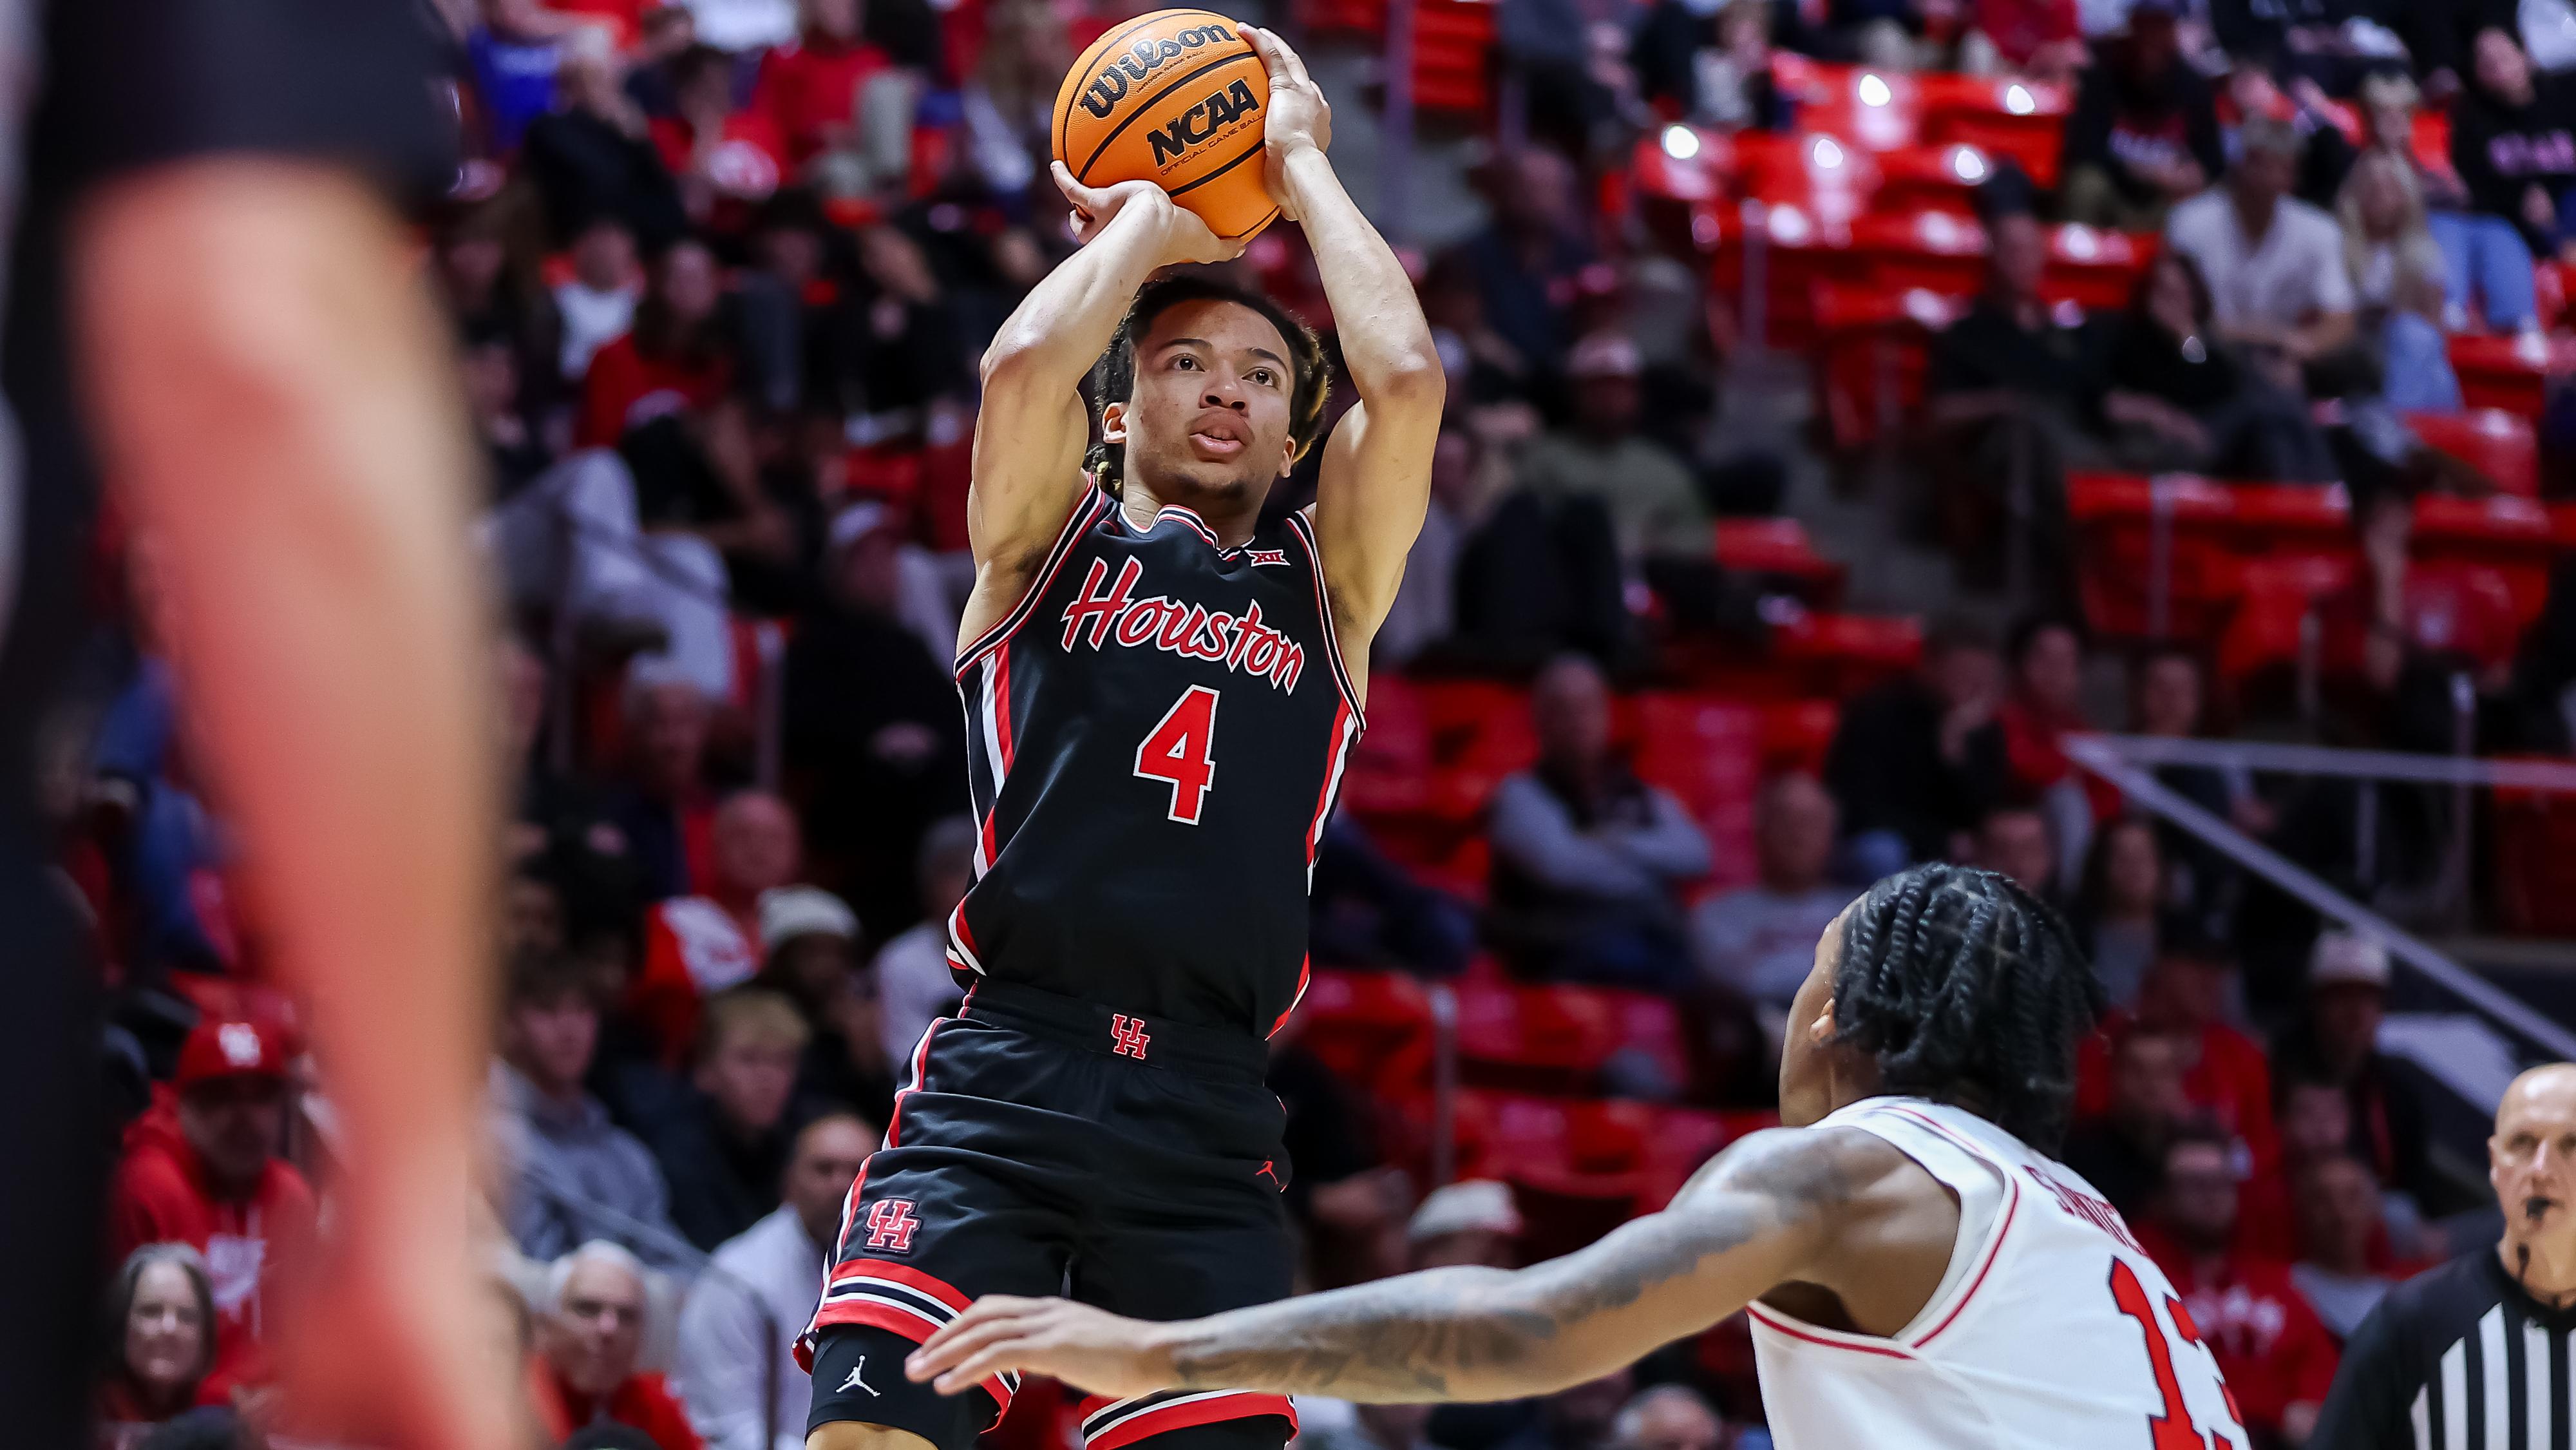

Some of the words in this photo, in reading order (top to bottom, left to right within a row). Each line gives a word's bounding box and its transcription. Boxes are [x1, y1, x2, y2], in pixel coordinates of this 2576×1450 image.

[1079, 24, 1236, 119] Wilson
[1146, 77, 1260, 167] NCAA
[1160, 148, 1207, 176] OFFICIAL
[1208, 128, 1239, 148] GAME
[1240, 115, 1264, 129] BALL
[1061, 555, 1305, 696] Houston
[1133, 684, 1220, 825] 4
[1111, 1013, 1150, 1060] UH
[867, 1199, 918, 1250] UH
